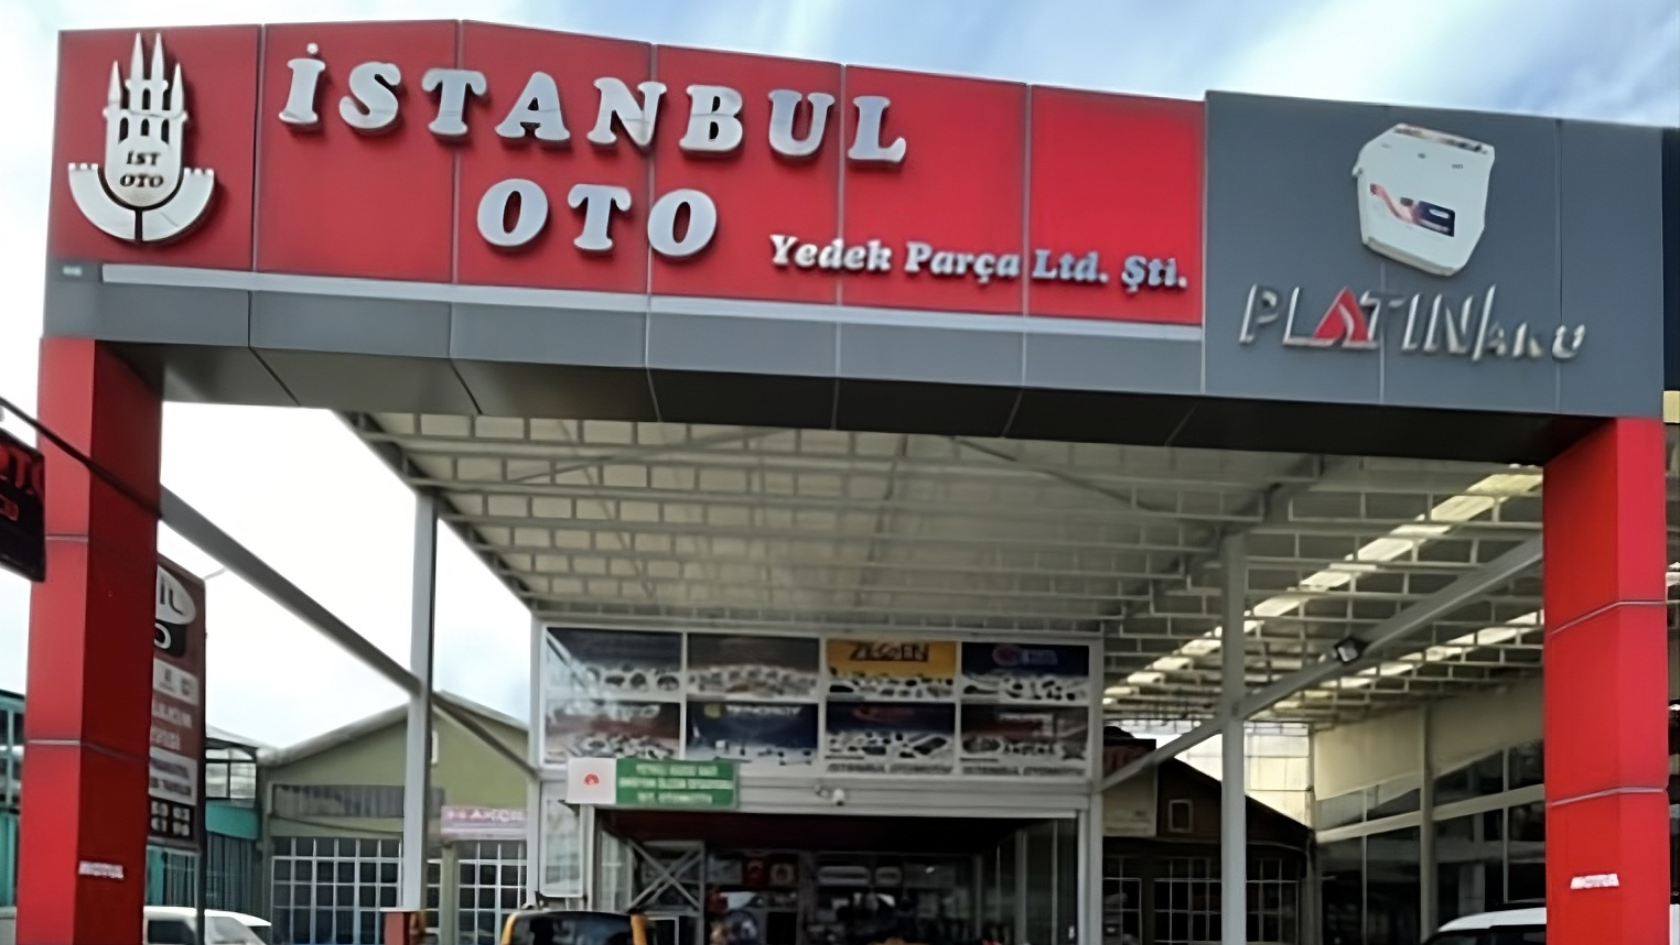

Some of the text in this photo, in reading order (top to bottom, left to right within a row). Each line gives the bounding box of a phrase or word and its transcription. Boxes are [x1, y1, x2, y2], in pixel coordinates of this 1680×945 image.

[278, 43, 907, 165] İSTANBUL
[119, 174, 164, 188] OTO
[476, 178, 718, 258] OTO
[769, 234, 1188, 293] Yedek Parça Ltd. Şti.
